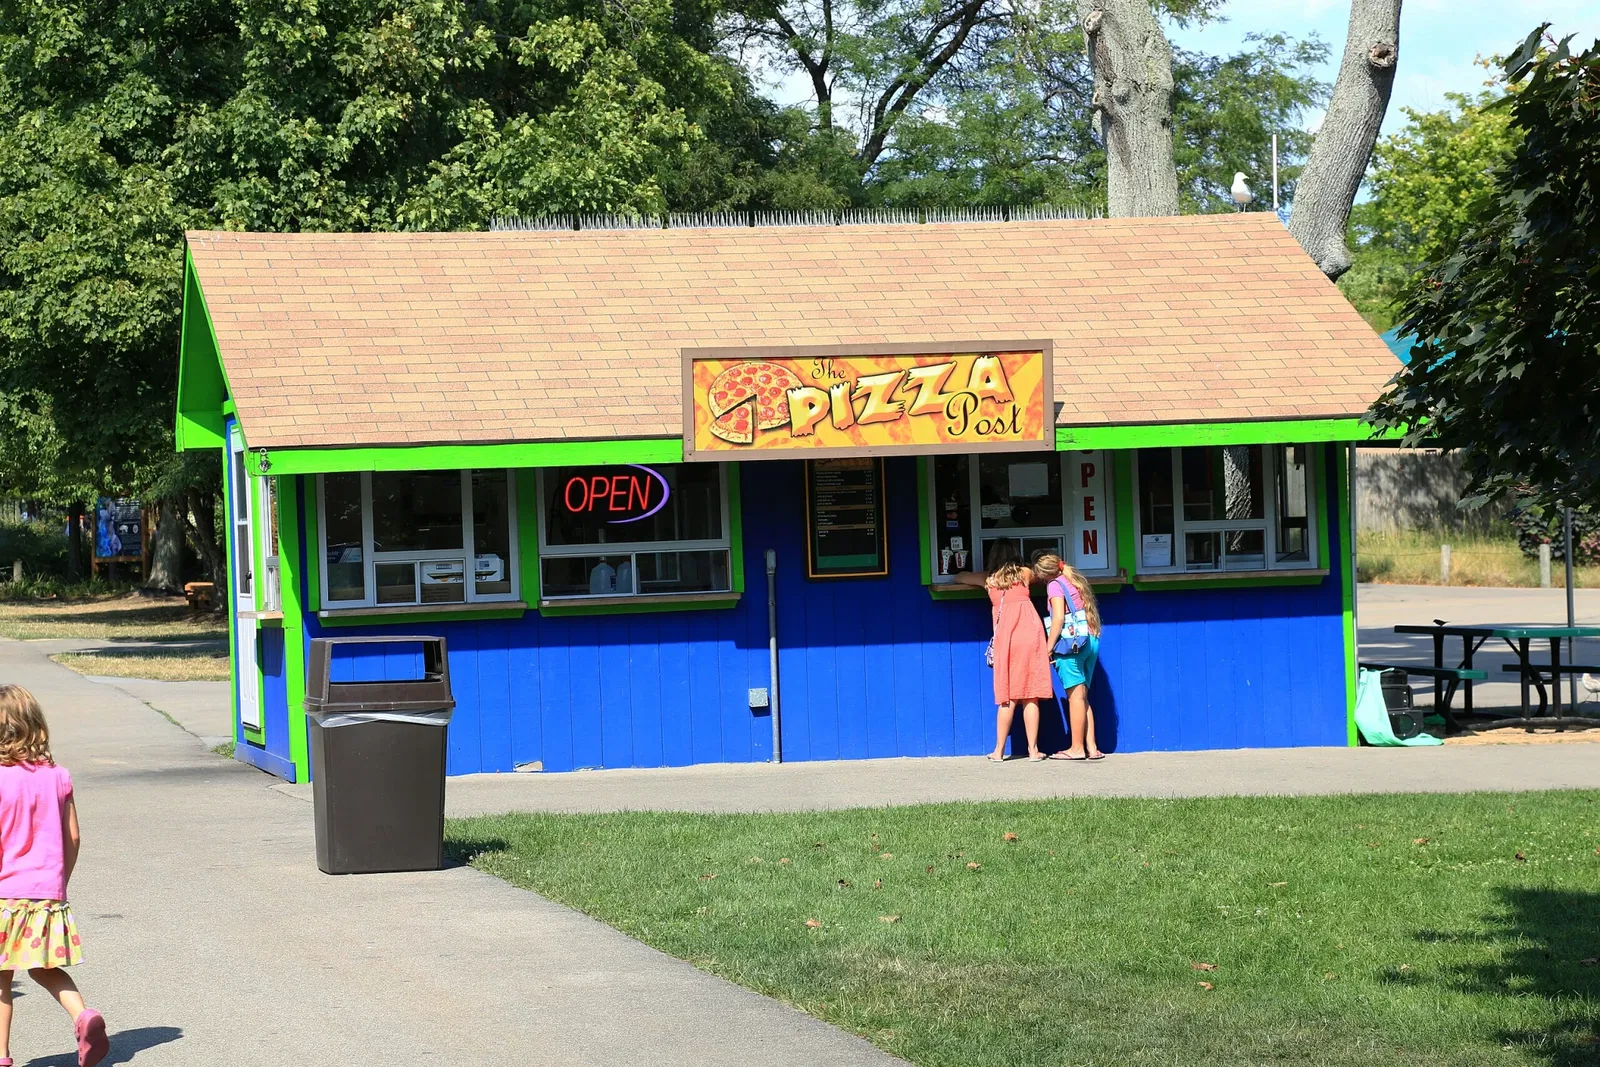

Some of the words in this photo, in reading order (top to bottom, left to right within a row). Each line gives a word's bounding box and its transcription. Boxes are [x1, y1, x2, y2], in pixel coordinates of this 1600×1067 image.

[811, 357, 847, 380] The
[785, 354, 1016, 438] PIZZA
[946, 391, 1023, 436] Post
[565, 475, 651, 512] OPEN
[1080, 450, 1098, 555] PEN
